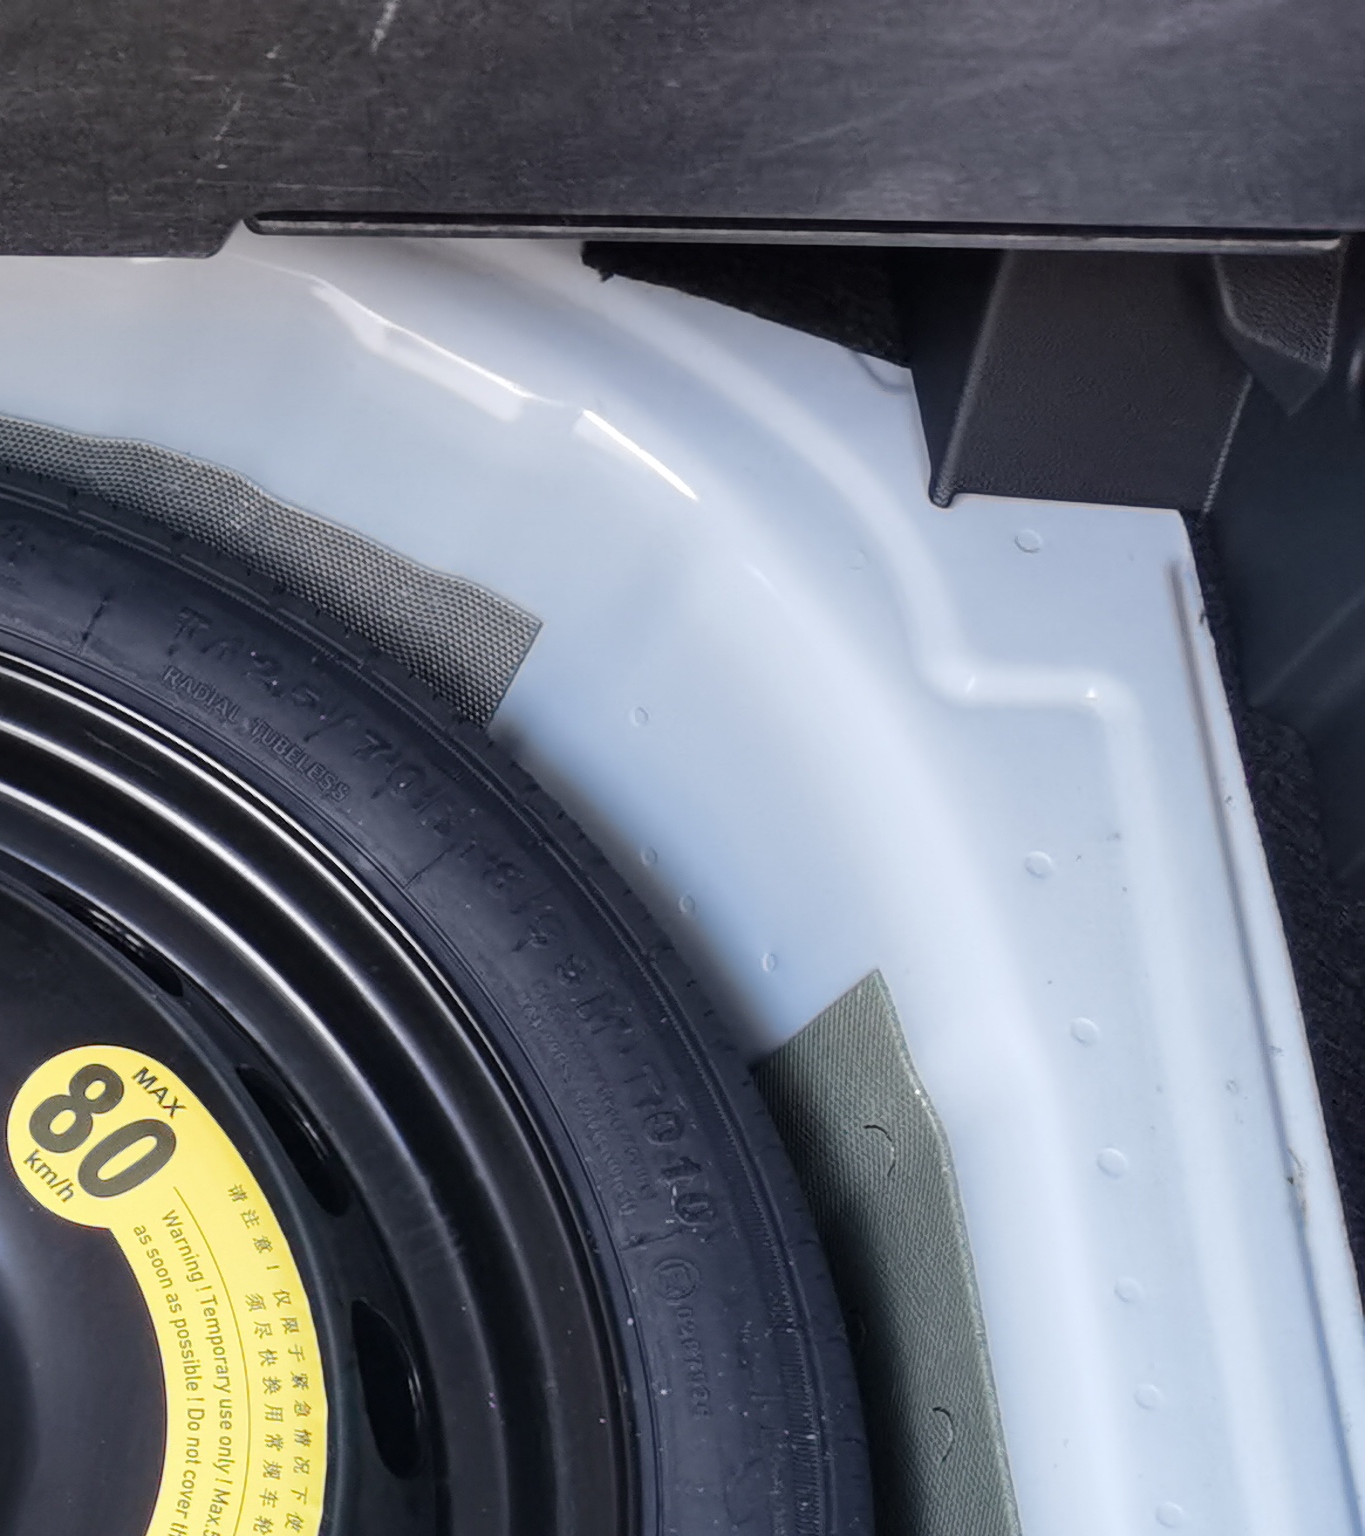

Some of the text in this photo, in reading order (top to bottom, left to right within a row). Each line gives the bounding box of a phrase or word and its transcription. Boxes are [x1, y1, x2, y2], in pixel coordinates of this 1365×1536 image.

[158, 663, 355, 804] RADIAL TUBELESS
[132, 1066, 188, 1120] MAX
[27, 1063, 178, 1198] 80
[25, 1148, 79, 1205] km/h
[132, 1224, 153, 1247] as
[161, 1208, 203, 1284] Warning
[145, 1247, 174, 1290] soon
[164, 1292, 184, 1315] as
[168, 1317, 203, 1393] possible
[199, 1293, 232, 1395] Temporary
[186, 1407, 206, 1433] Do
[218, 1397, 233, 1431] use
[184, 1436, 202, 1466] not
[211, 1435, 236, 1476] only
[174, 1468, 198, 1520] cover
